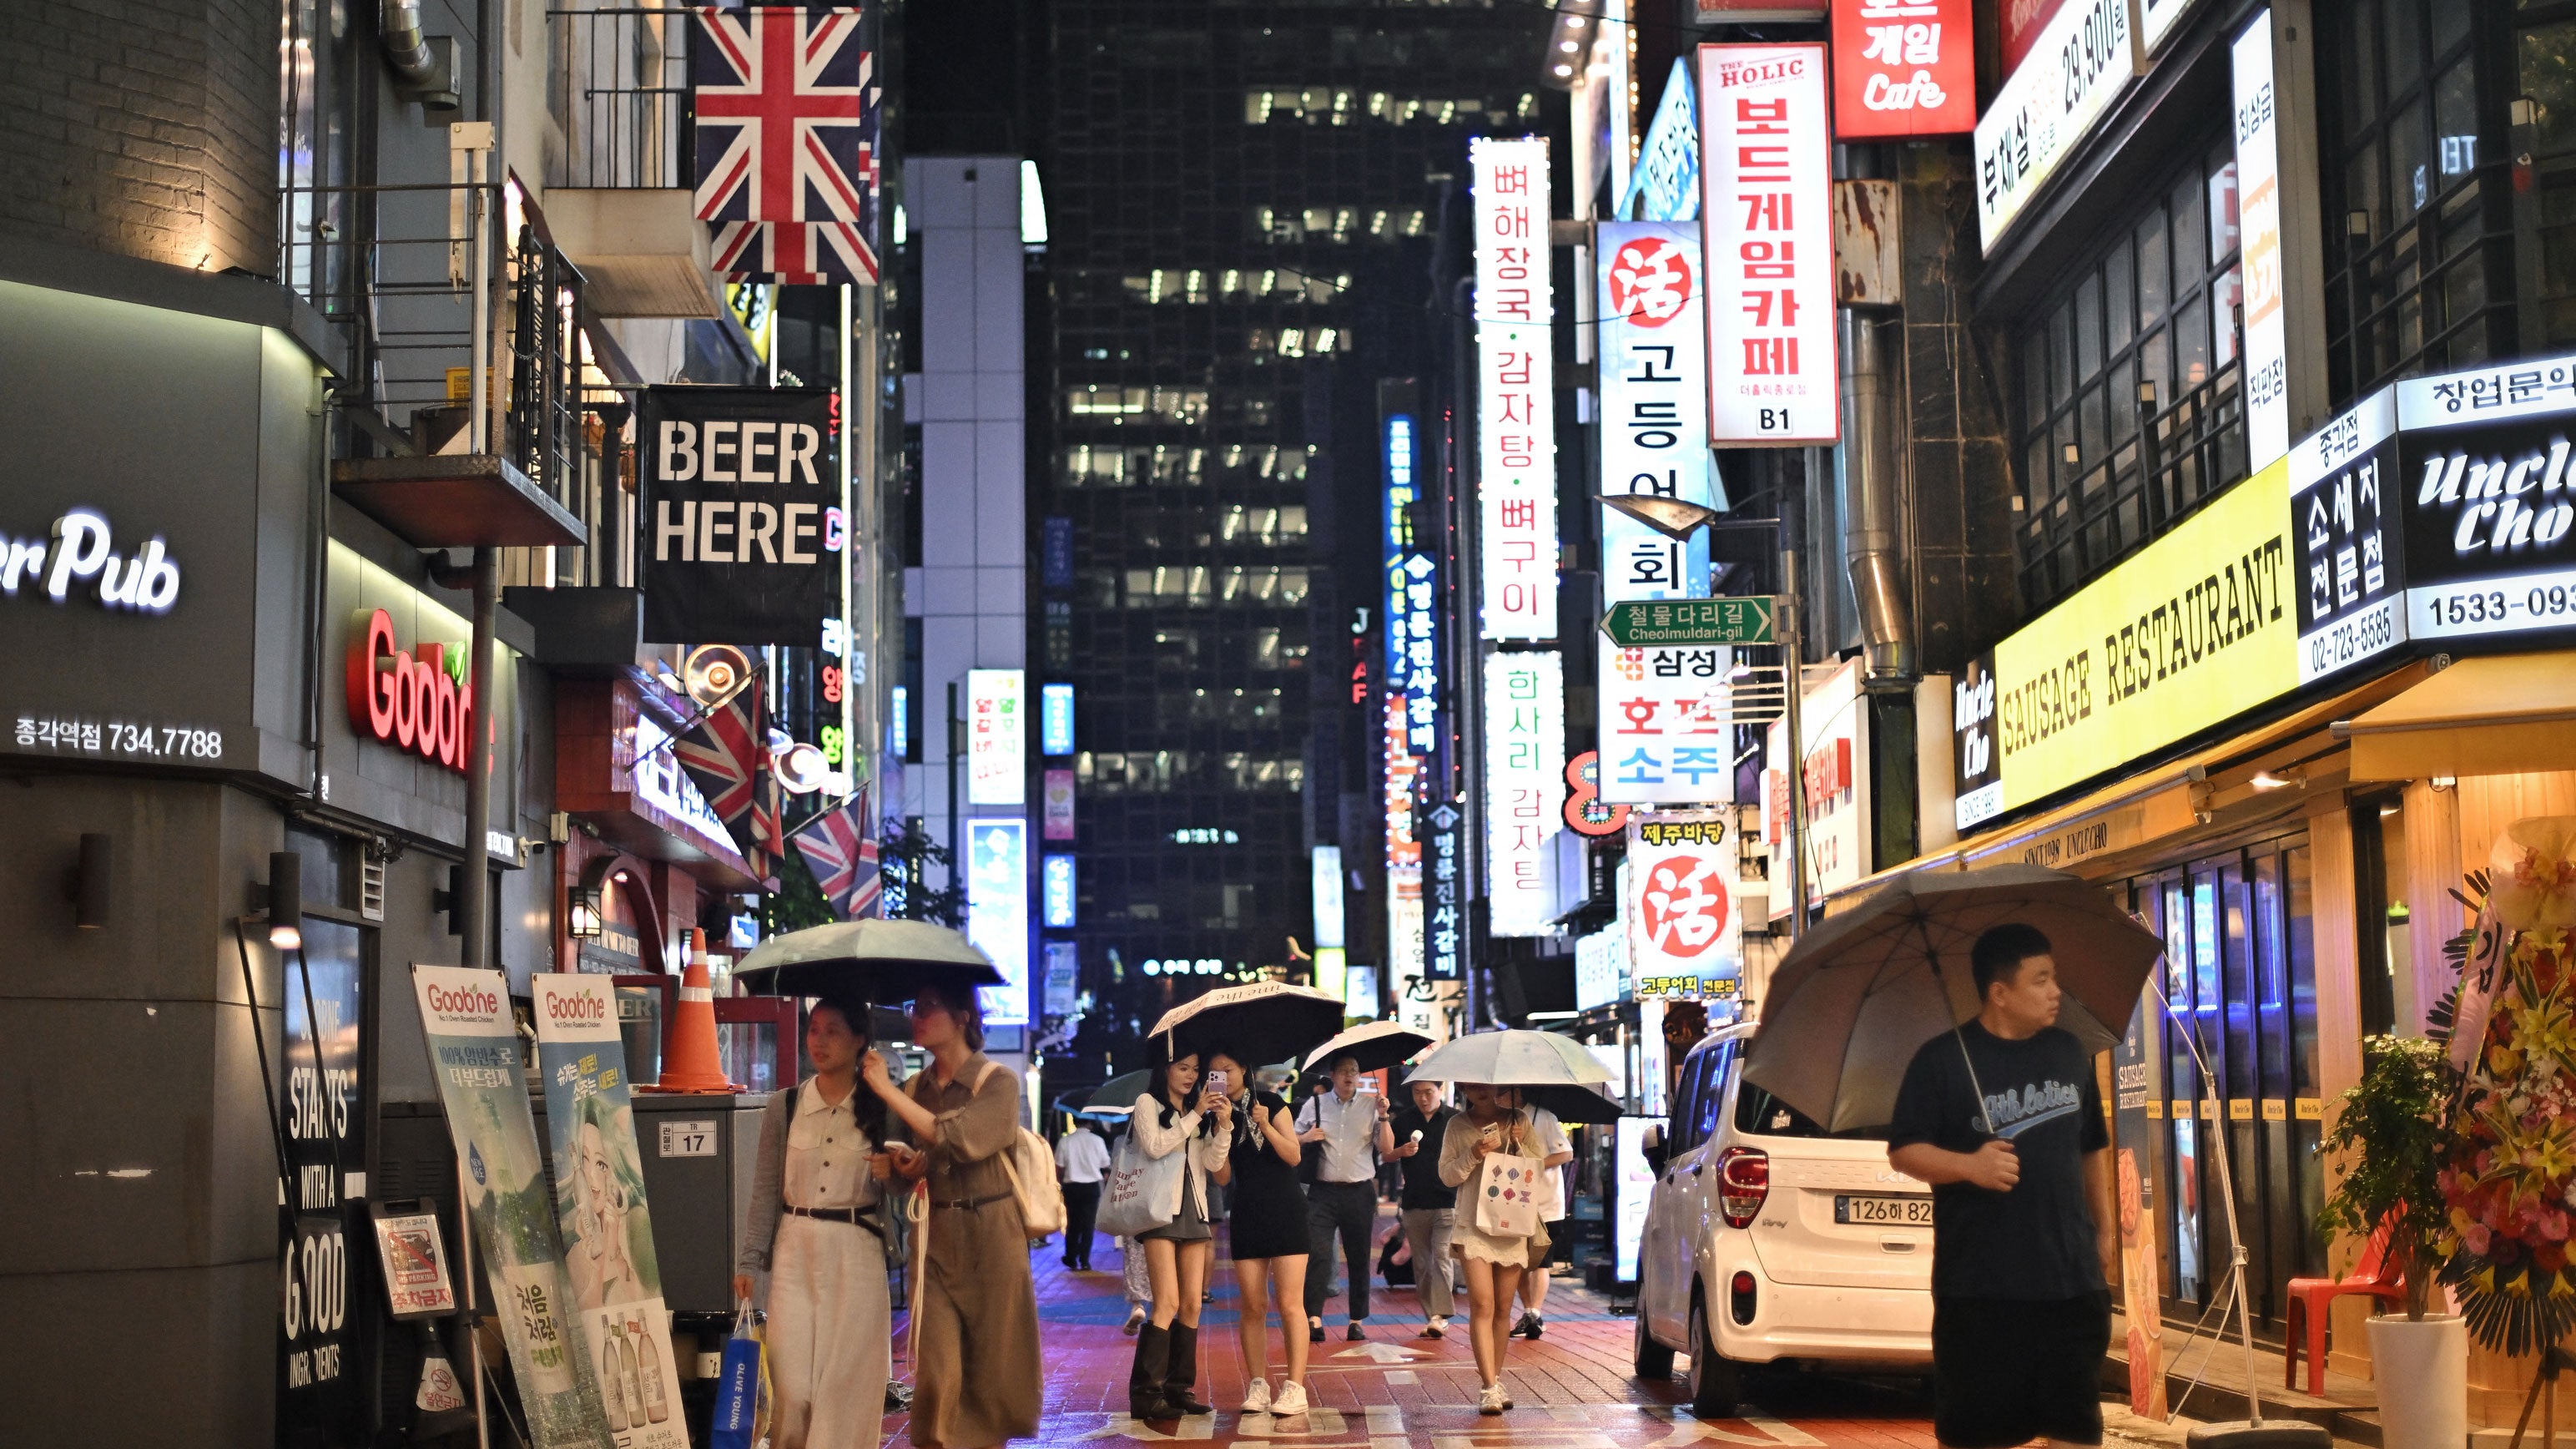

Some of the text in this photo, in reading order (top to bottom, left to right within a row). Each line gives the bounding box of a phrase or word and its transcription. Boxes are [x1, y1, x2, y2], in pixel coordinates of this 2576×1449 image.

[1863, 23, 1941, 65] 게임
[1722, 59, 1802, 88] HOLIC
[1863, 70, 1946, 110] Cafe
[2239, 81, 2271, 145] 최상급
[1983, 106, 2030, 215] 부채살
[1737, 98, 1800, 375] 보드게임카페
[1614, 242, 1682, 322] 活
[2250, 356, 2283, 409] 직판장
[2433, 366, 2576, 413] 창업문의
[1498, 352, 1534, 467] 감자탕
[1761, 408, 1788, 430] B1
[658, 421, 819, 484] BEER
[2320, 411, 2358, 468] 종각점
[2309, 457, 2380, 553] 소세지
[2454, 499, 2573, 551] Cho
[656, 501, 818, 564] HERE
[48, 512, 179, 608] Pub
[2311, 530, 2384, 620] 전문점
[1629, 603, 1743, 627] 철물다리길
[1629, 626, 1743, 641] Cheolmuldari-gil
[1652, 650, 1717, 677] 삼성
[2004, 535, 2284, 757] SAUSAGE RESTAURANT
[2312, 607, 2391, 673] 02-723-5585
[1509, 670, 1540, 770] 한사리
[1616, 697, 1719, 735] 호프
[1956, 669, 1994, 731] Uncle
[15, 718, 222, 759] 종각역점 734.7788
[1964, 727, 1989, 779] Cho
[1617, 748, 1719, 785] 소주
[1641, 820, 1725, 846] 제주바당
[1647, 860, 1717, 951] 活
[1641, 976, 1698, 995] 고등어회
[683, 1135, 704, 1151] 17
[301, 1164, 335, 1209] WITH A
[1853, 1200, 1903, 1220] 126하
[393, 1288, 451, 1310] 주차금지
[516, 1285, 547, 1315] 처음
[524, 1315, 557, 1342] 처럼
[290, 1344, 340, 1389] INGRIENTS
[730, 1363, 745, 1430] OLIVE YOUNG
